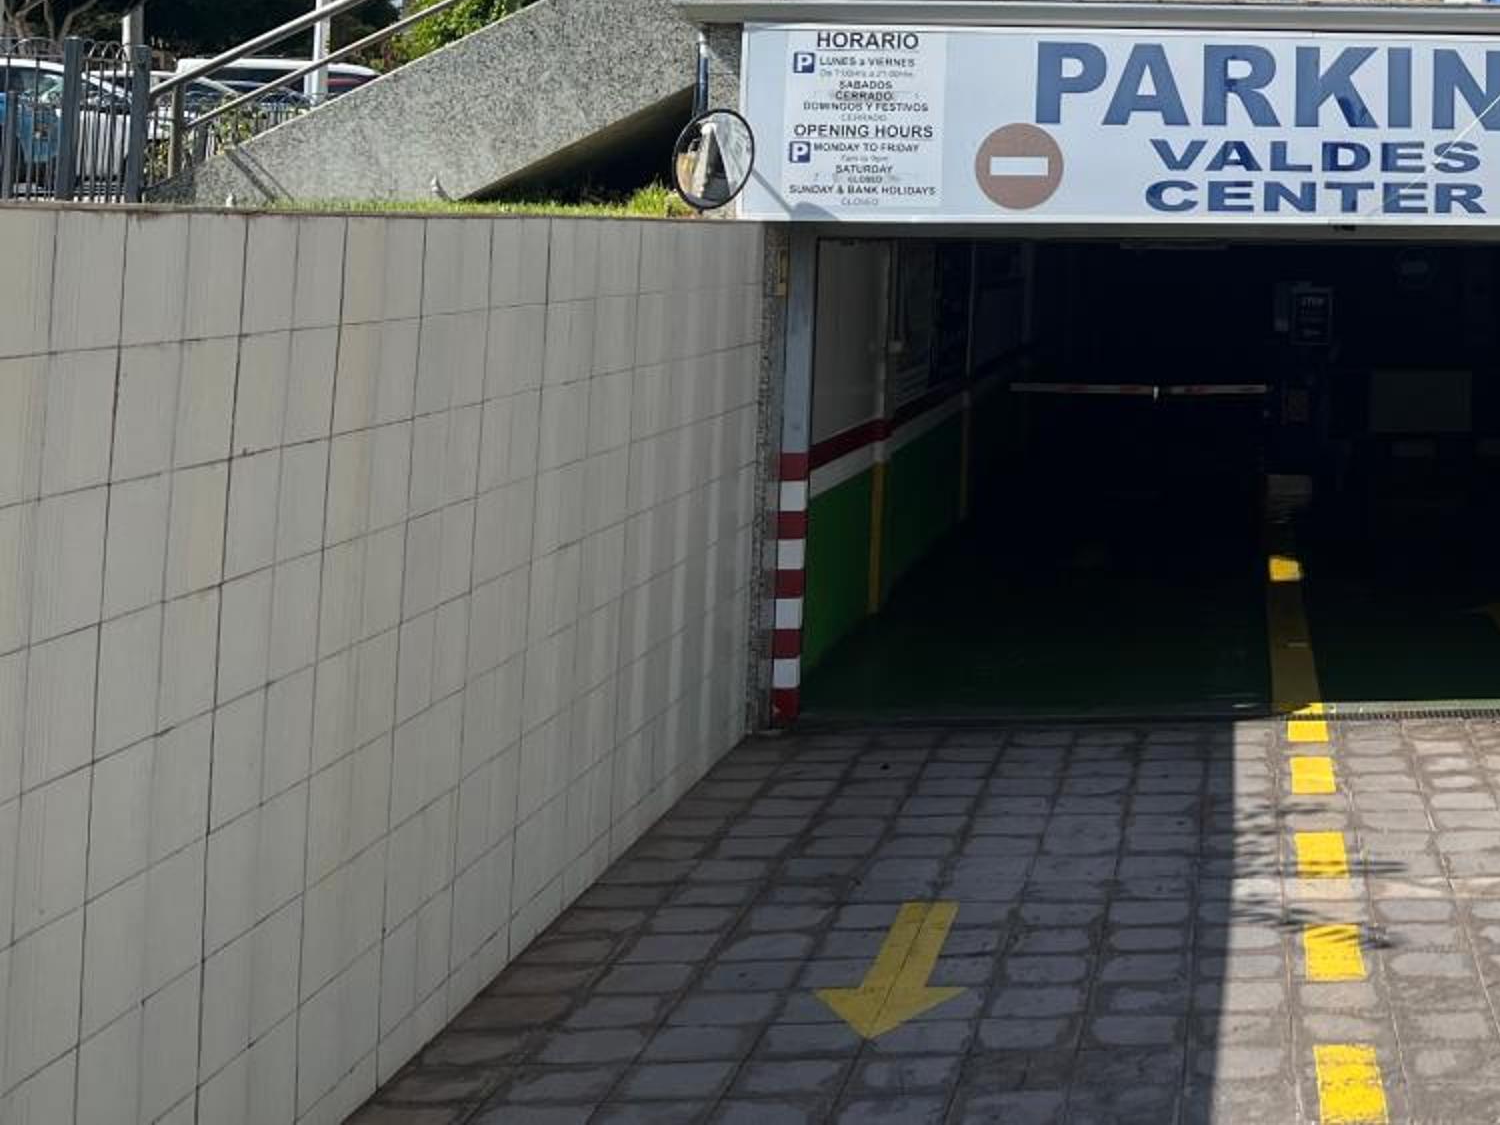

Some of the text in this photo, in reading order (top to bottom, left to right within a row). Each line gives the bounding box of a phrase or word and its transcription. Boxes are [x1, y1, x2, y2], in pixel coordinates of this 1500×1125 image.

[817, 32, 919, 50] HORARIO
[819, 56, 857, 66] LUNES
[868, 57, 915, 67] VIERNES
[835, 90, 893, 102] CERRADO
[803, 101, 863, 112] DOMINGOS
[875, 102, 929, 113] FESTIVOS
[794, 125, 934, 139] OPENING HOURS
[813, 142, 920, 153] MONDAY TO FRIDAY
[1149, 137, 1482, 173] VALDES
[835, 164, 894, 174] SATURDAY
[789, 184, 833, 194] SUNDAY
[847, 185, 879, 195] BANK
[881, 186, 936, 196] HOLIDAYS
[1145, 179, 1488, 214] CENTER
